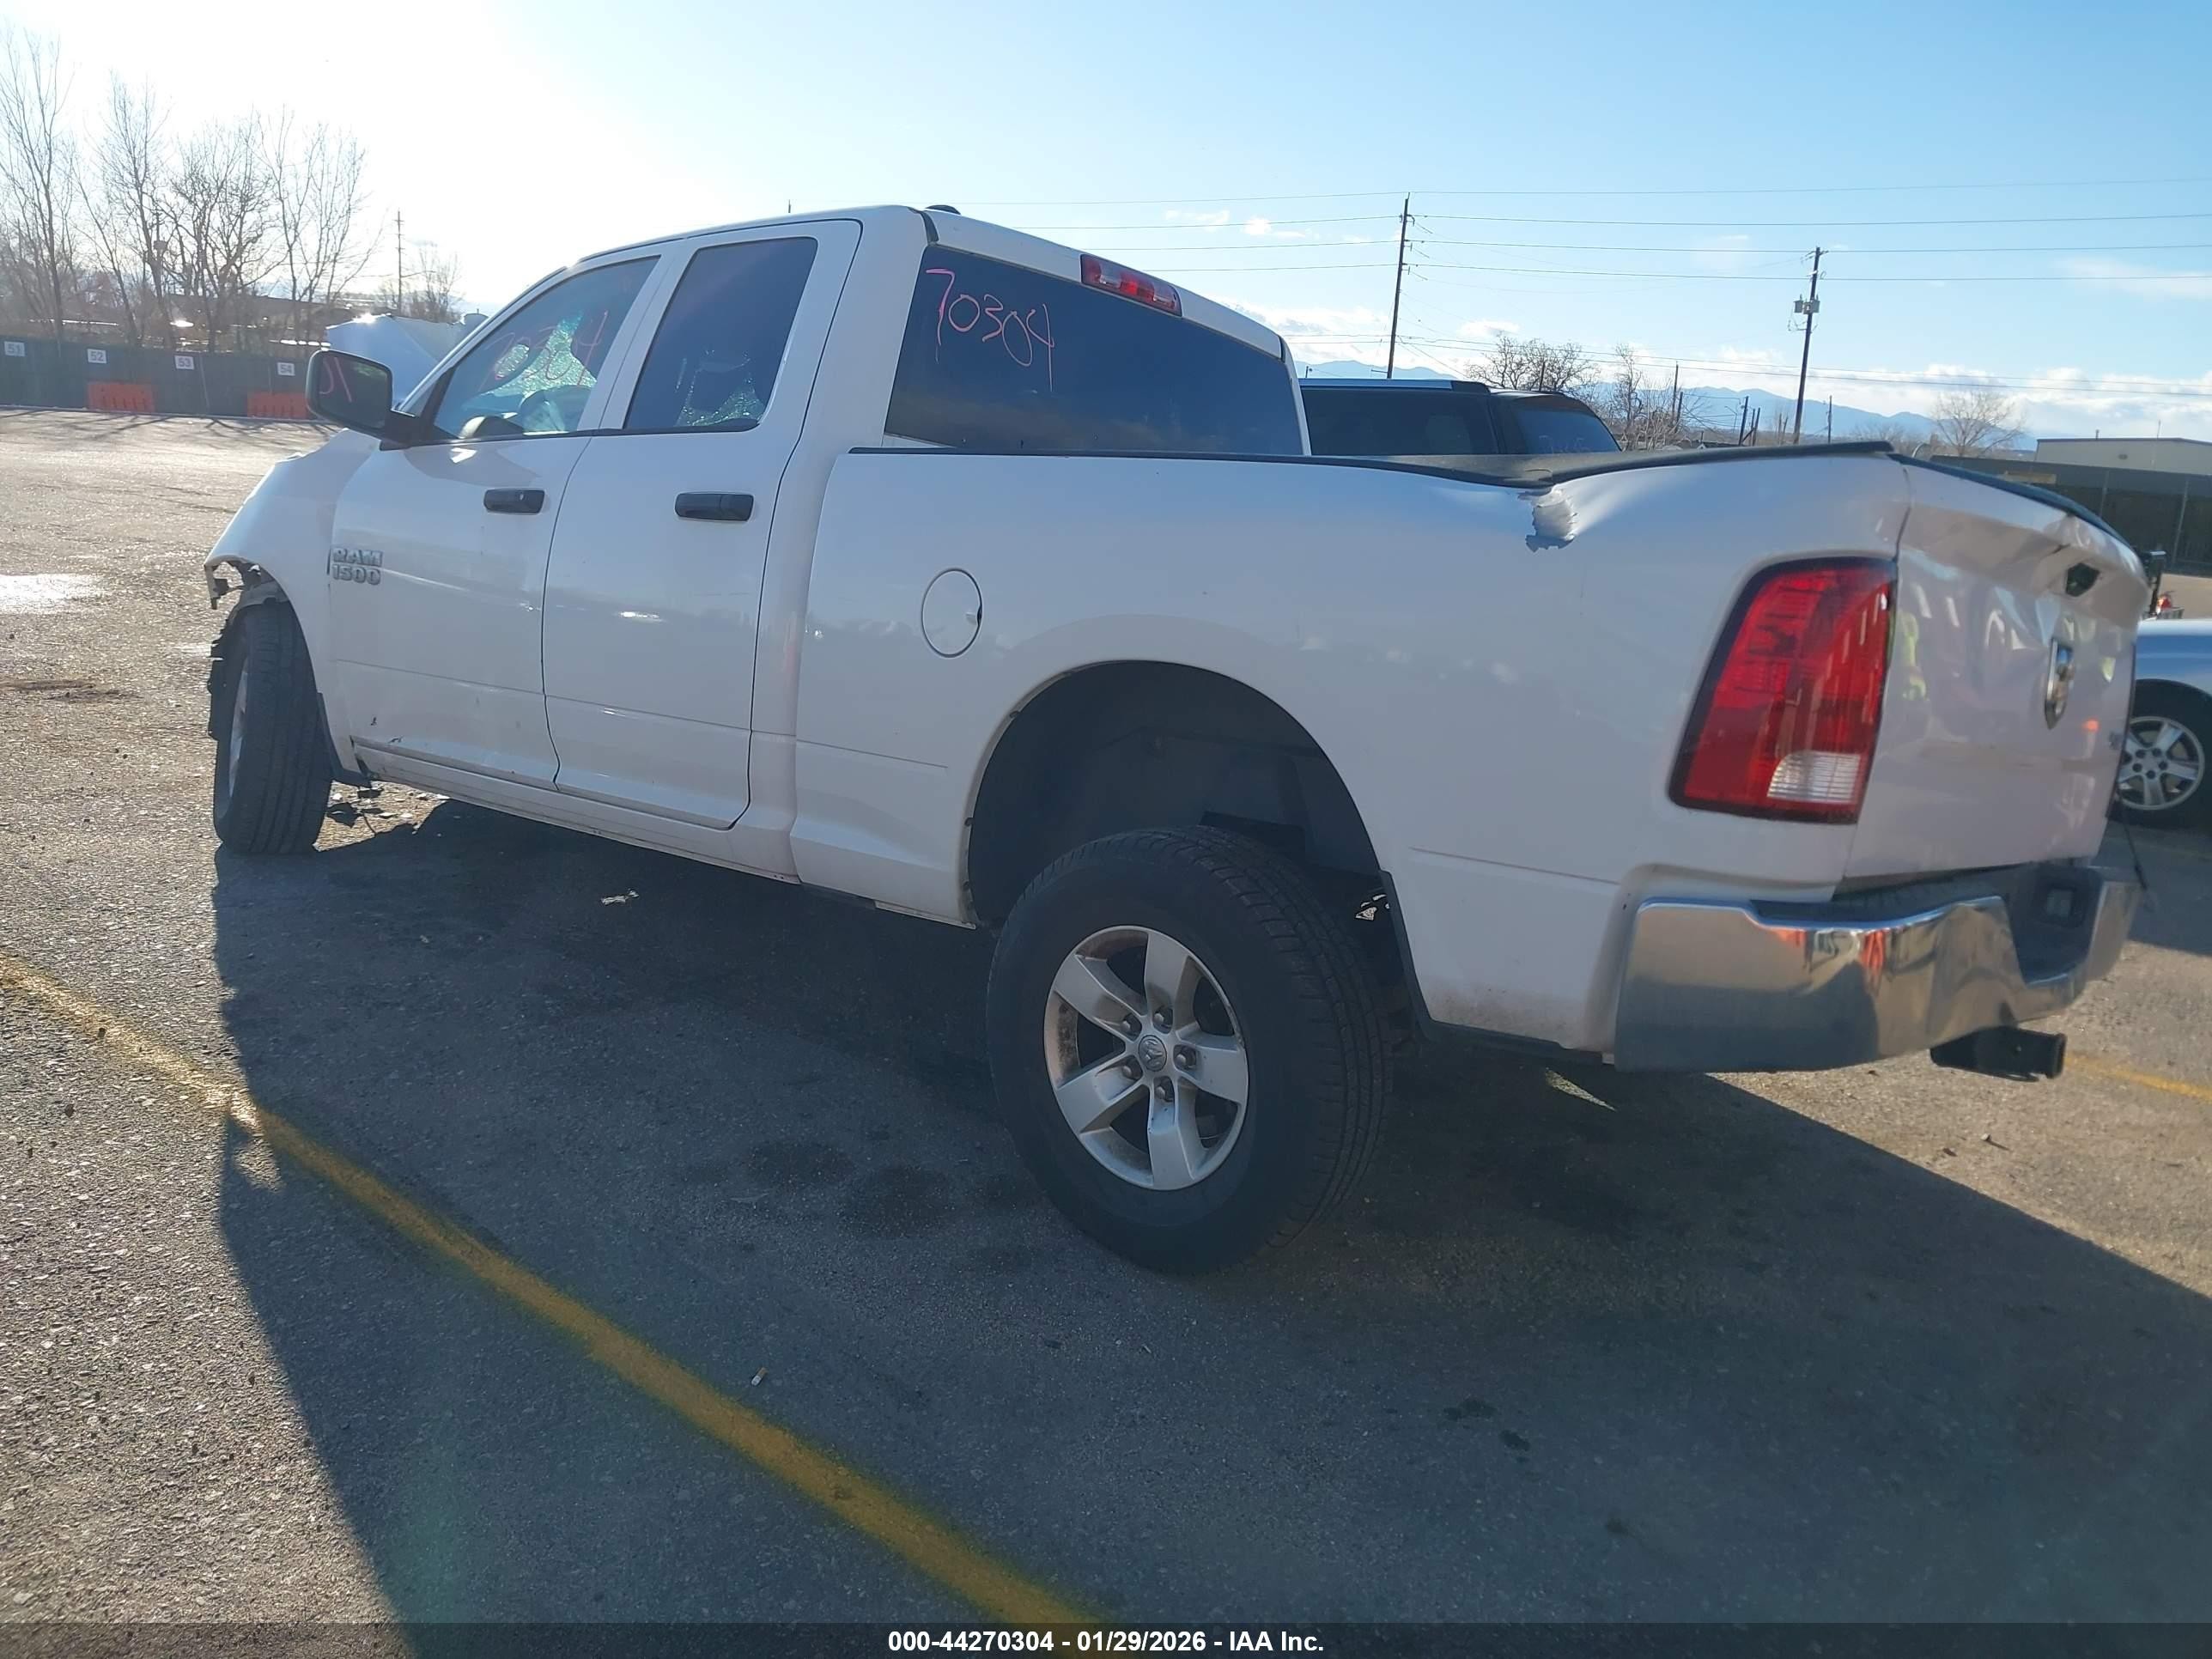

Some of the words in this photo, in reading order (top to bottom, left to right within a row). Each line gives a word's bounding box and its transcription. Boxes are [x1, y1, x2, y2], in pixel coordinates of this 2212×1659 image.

[926, 268, 1055, 392] 70304
[90, 350, 104, 362] 52
[177, 356, 192, 368] 53
[332, 548, 384, 568] RAM
[331, 563, 381, 586] 1500
